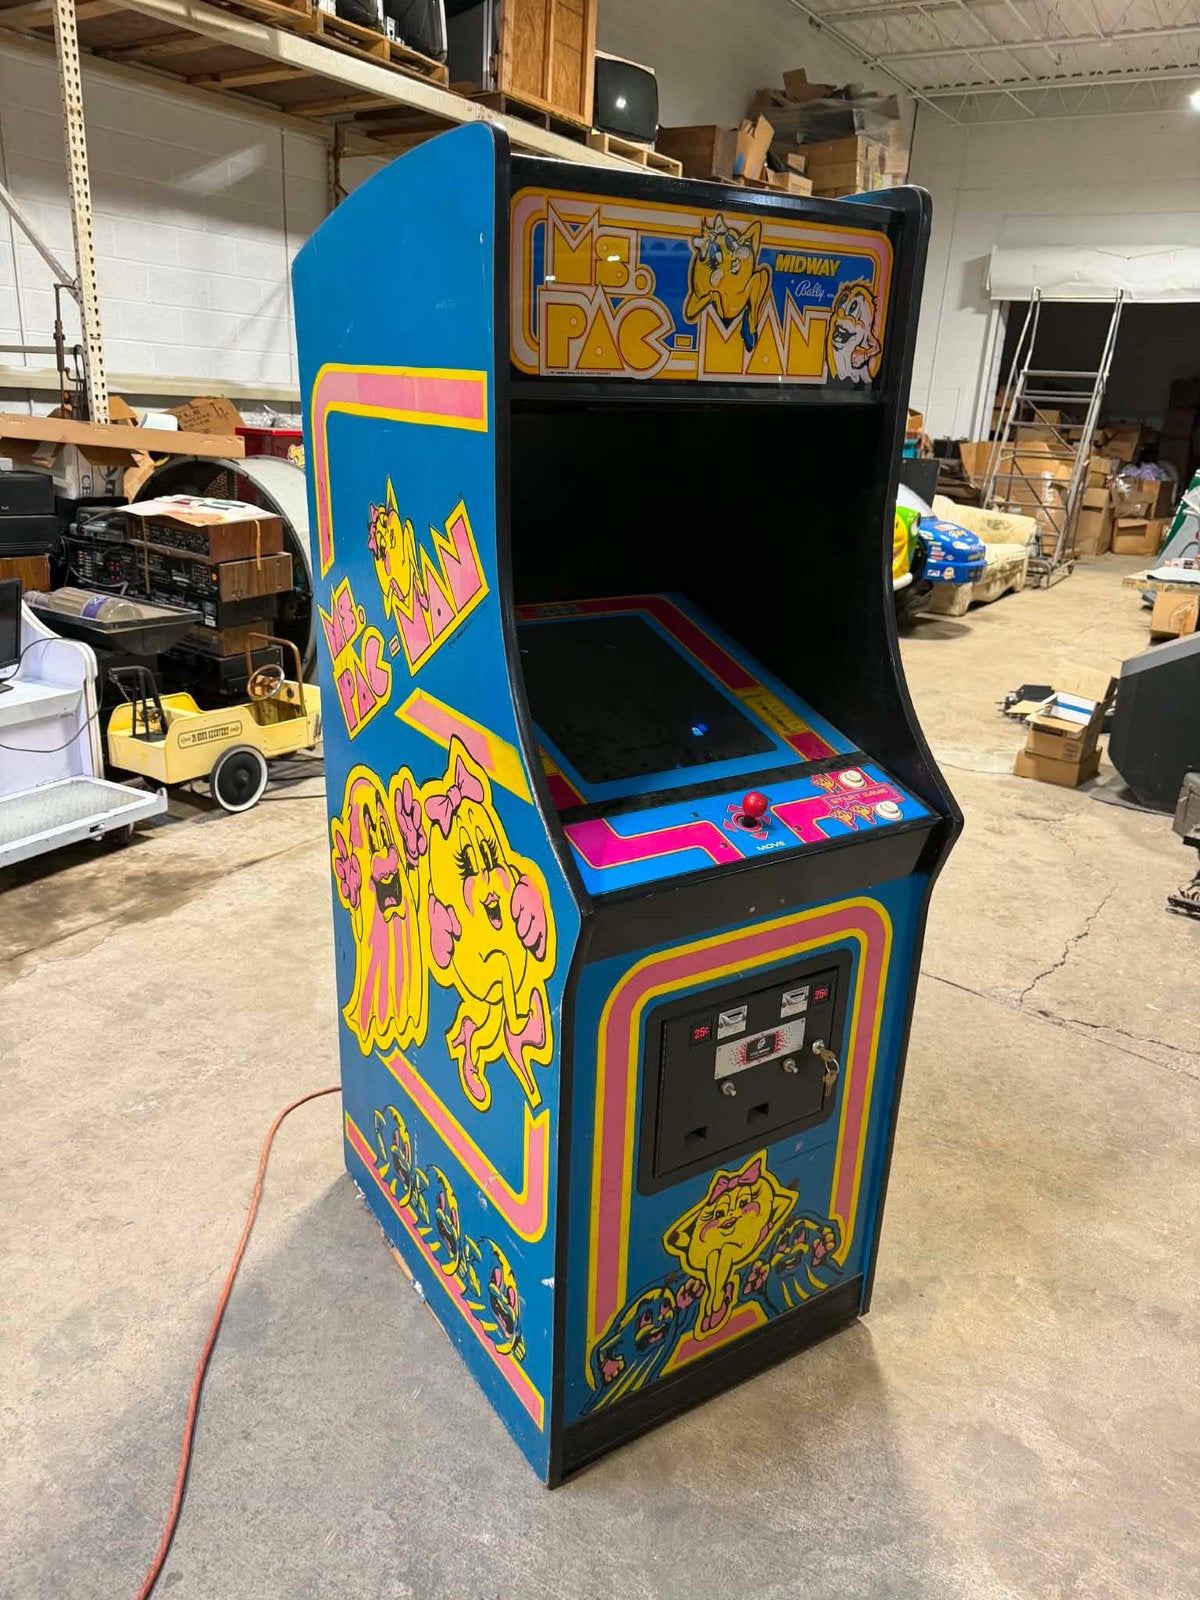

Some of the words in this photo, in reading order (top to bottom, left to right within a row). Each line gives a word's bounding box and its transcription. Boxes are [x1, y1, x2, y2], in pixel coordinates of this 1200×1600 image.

[775, 253, 841, 277] MIDWAY
[795, 280, 825, 302] Bally
[540, 287, 834, 384] PAC-MAN
[756, 840, 786, 851] MOVE
